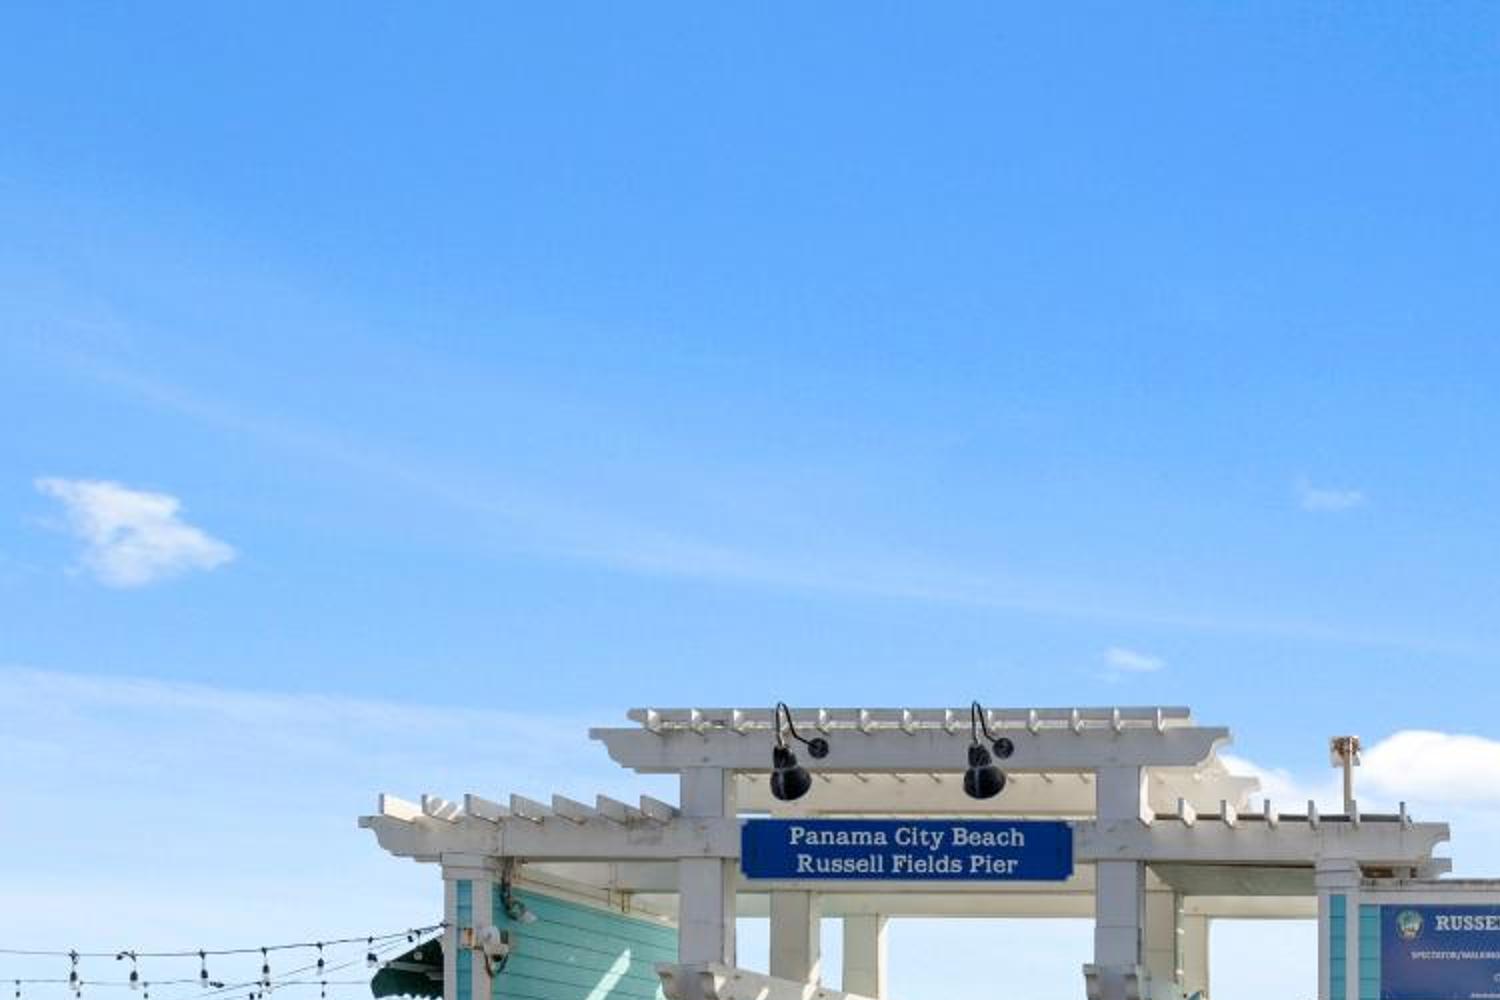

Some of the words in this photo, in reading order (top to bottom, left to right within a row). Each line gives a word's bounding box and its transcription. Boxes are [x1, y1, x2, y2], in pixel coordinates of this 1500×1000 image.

[789, 826, 888, 846] Panama
[895, 826, 944, 850] City
[952, 826, 1025, 847] Beach
[796, 853, 884, 873] Russell
[892, 853, 962, 873] Fields
[969, 853, 1018, 873] Pier
